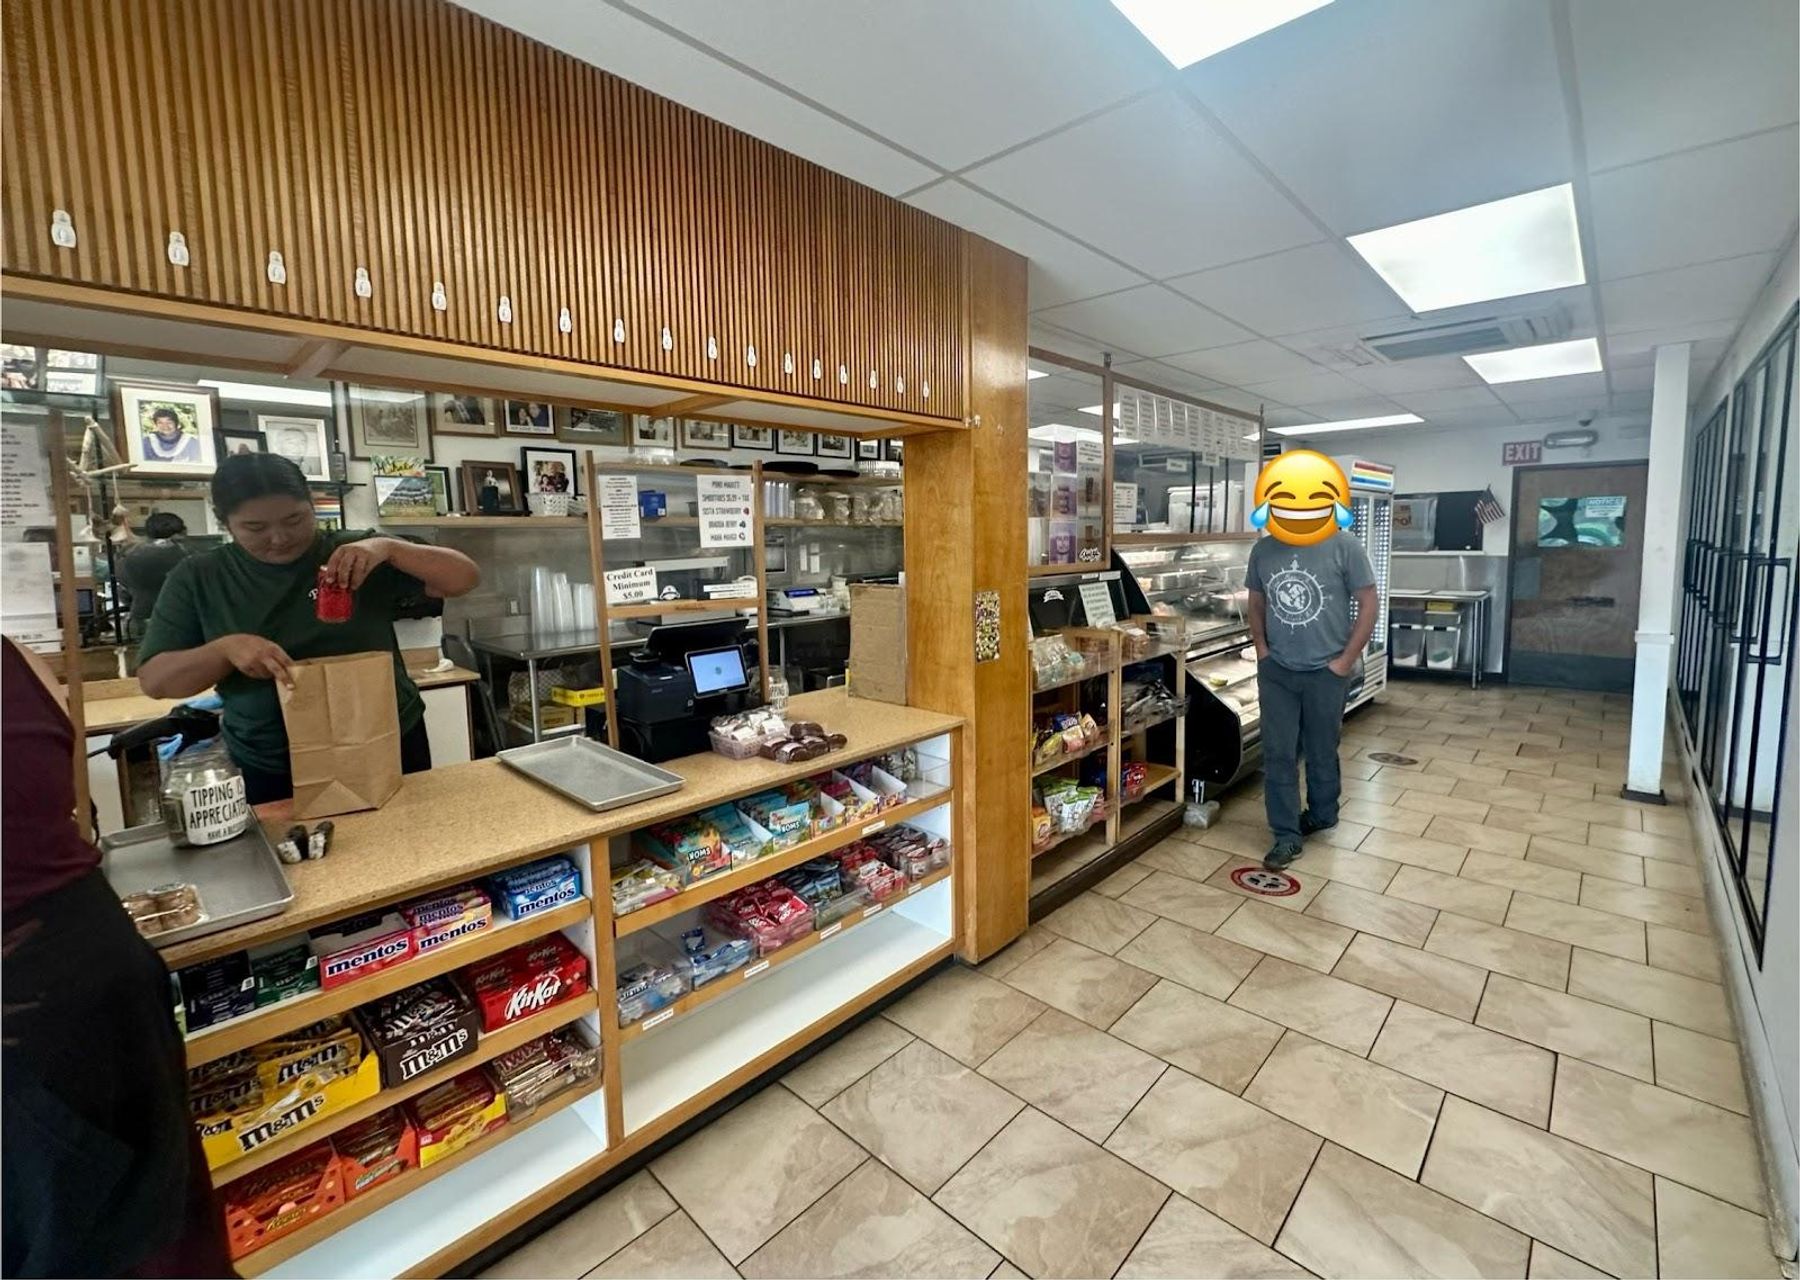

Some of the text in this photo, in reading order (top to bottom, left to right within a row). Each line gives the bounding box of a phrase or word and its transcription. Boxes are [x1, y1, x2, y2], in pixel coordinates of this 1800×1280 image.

[1505, 443, 1540, 462] EXIT
[606, 568, 653, 581] Credit Card
[613, 581, 651, 591] Minimum
[623, 590, 644, 599] $5.00
[190, 782, 233, 808] TIPPING
[519, 887, 576, 915] mentos
[419, 917, 487, 949] mentos
[327, 938, 409, 976] mentos
